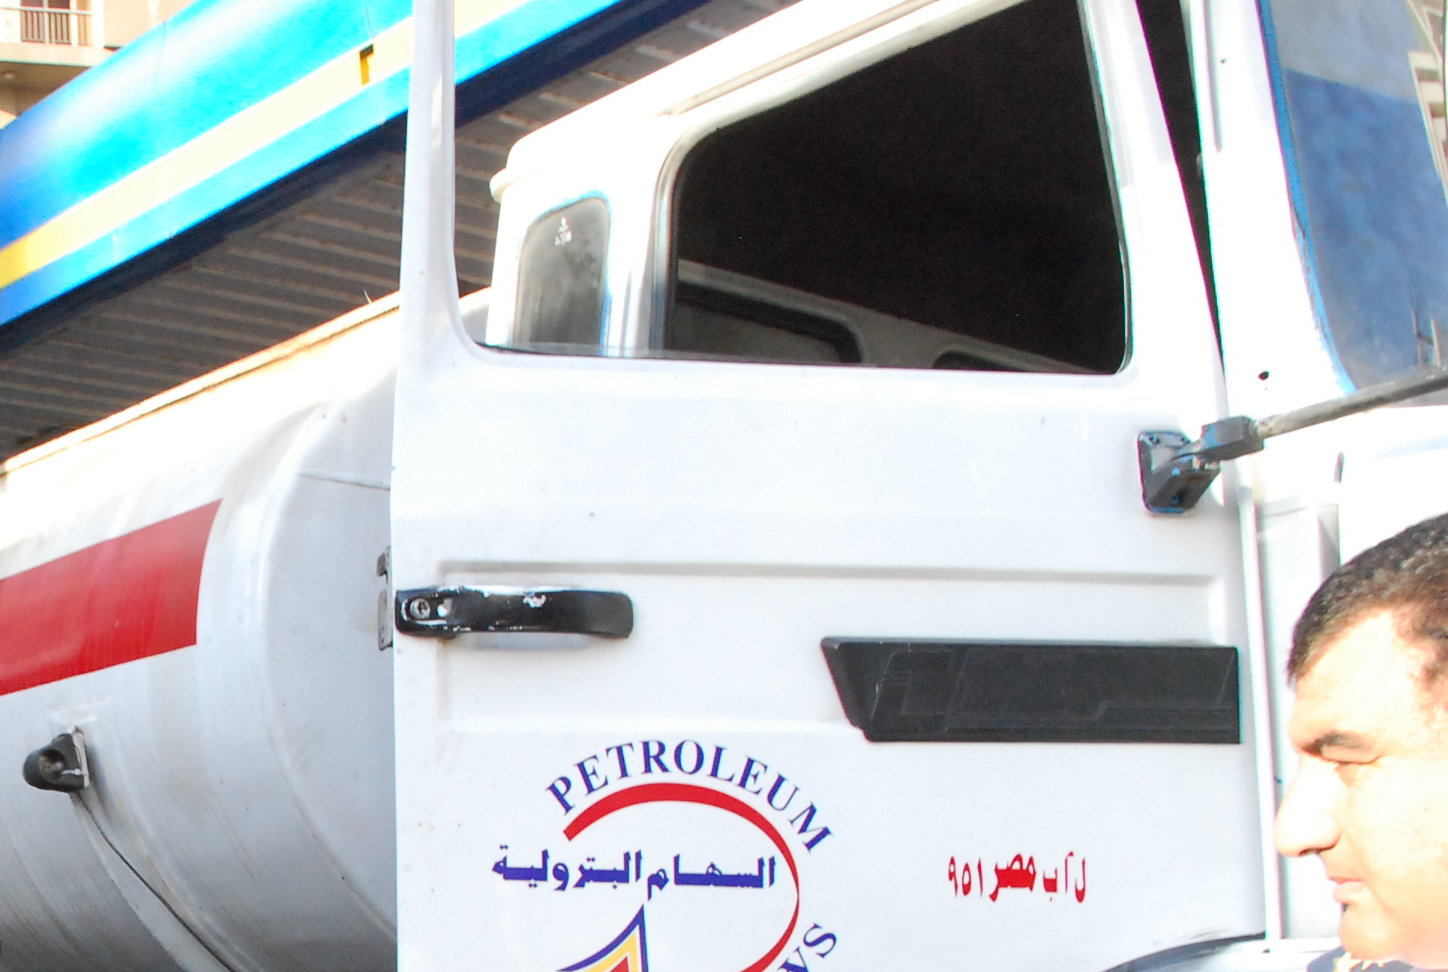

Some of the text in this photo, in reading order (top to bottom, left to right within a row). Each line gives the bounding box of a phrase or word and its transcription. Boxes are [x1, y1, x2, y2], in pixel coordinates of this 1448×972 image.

[545, 738, 834, 854] PETROLEUM
[491, 843, 777, 901] السهام البترولية
